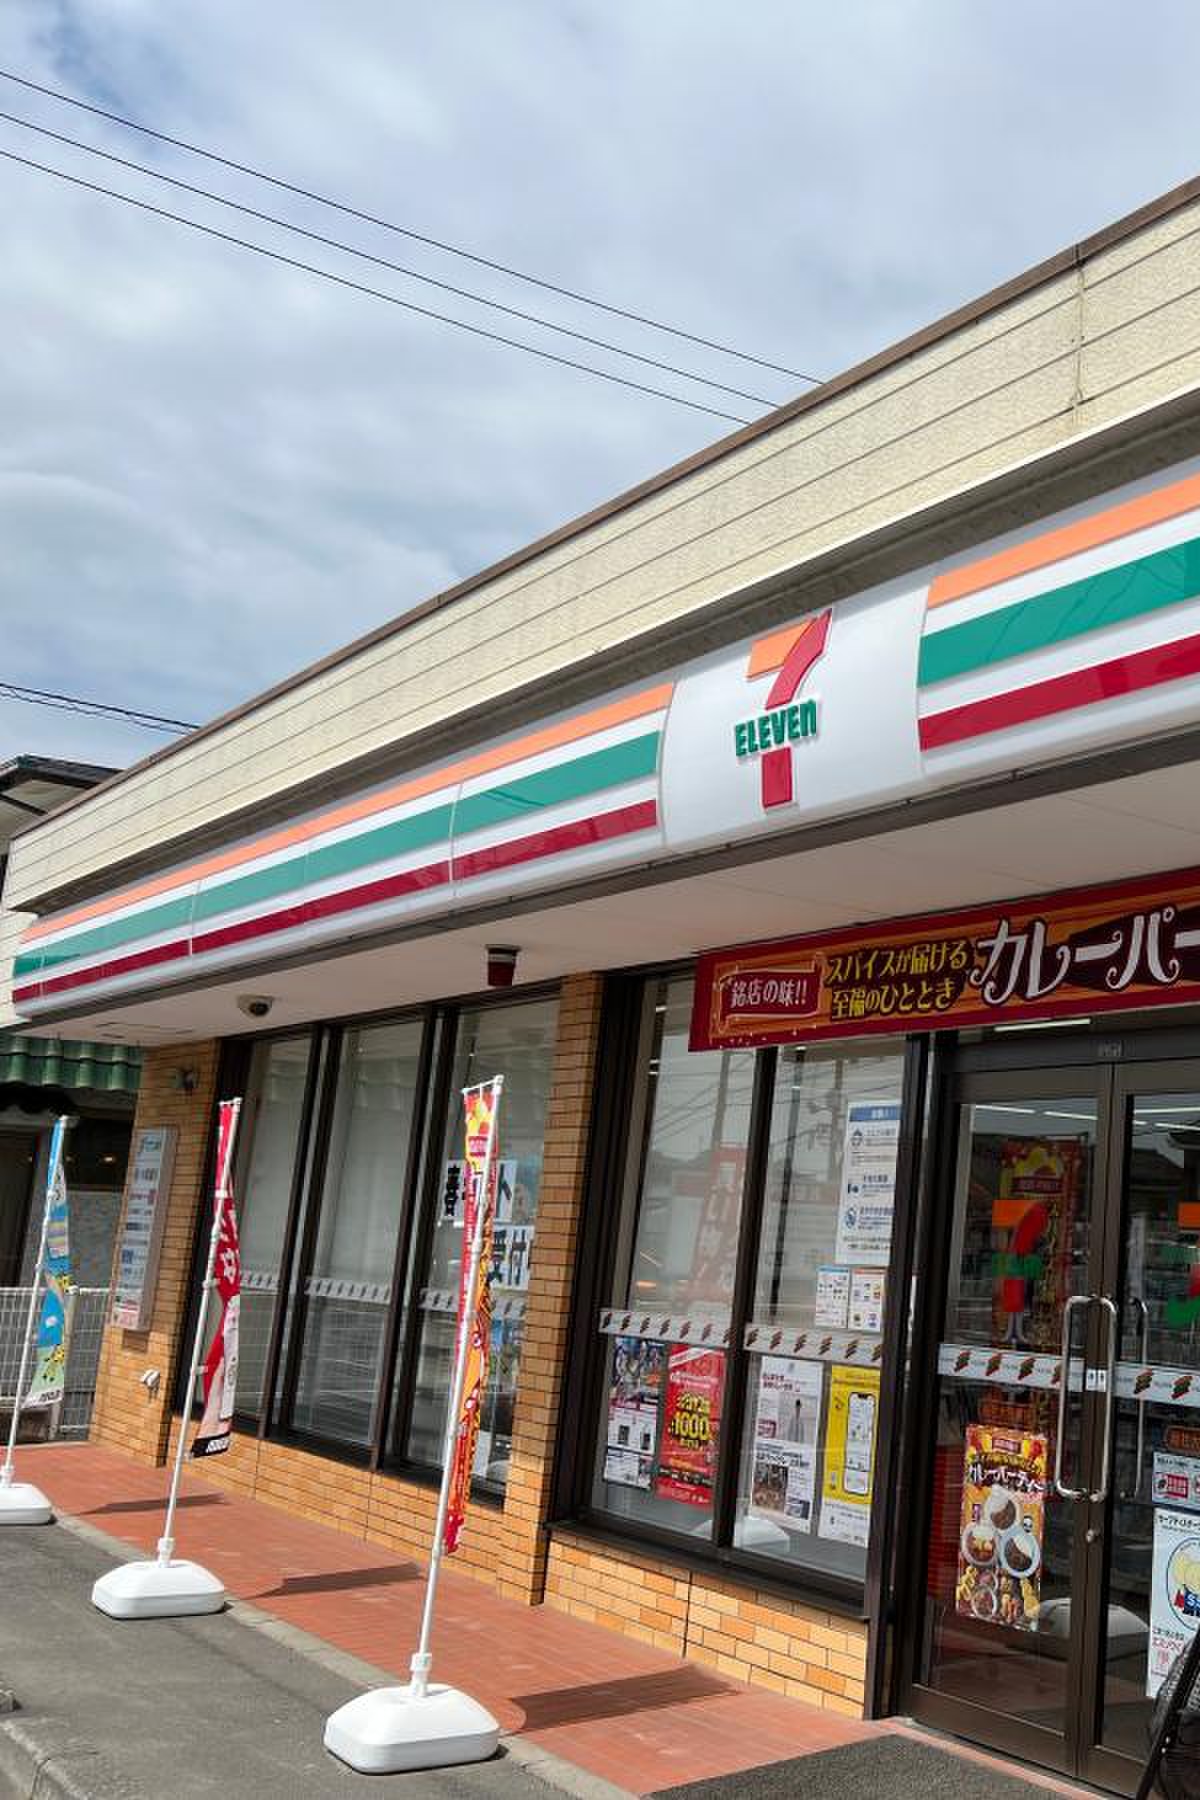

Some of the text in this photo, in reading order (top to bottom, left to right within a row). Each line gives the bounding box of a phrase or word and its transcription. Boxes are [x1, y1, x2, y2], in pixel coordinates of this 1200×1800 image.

[827, 940, 968, 984] スパイスが届ける
